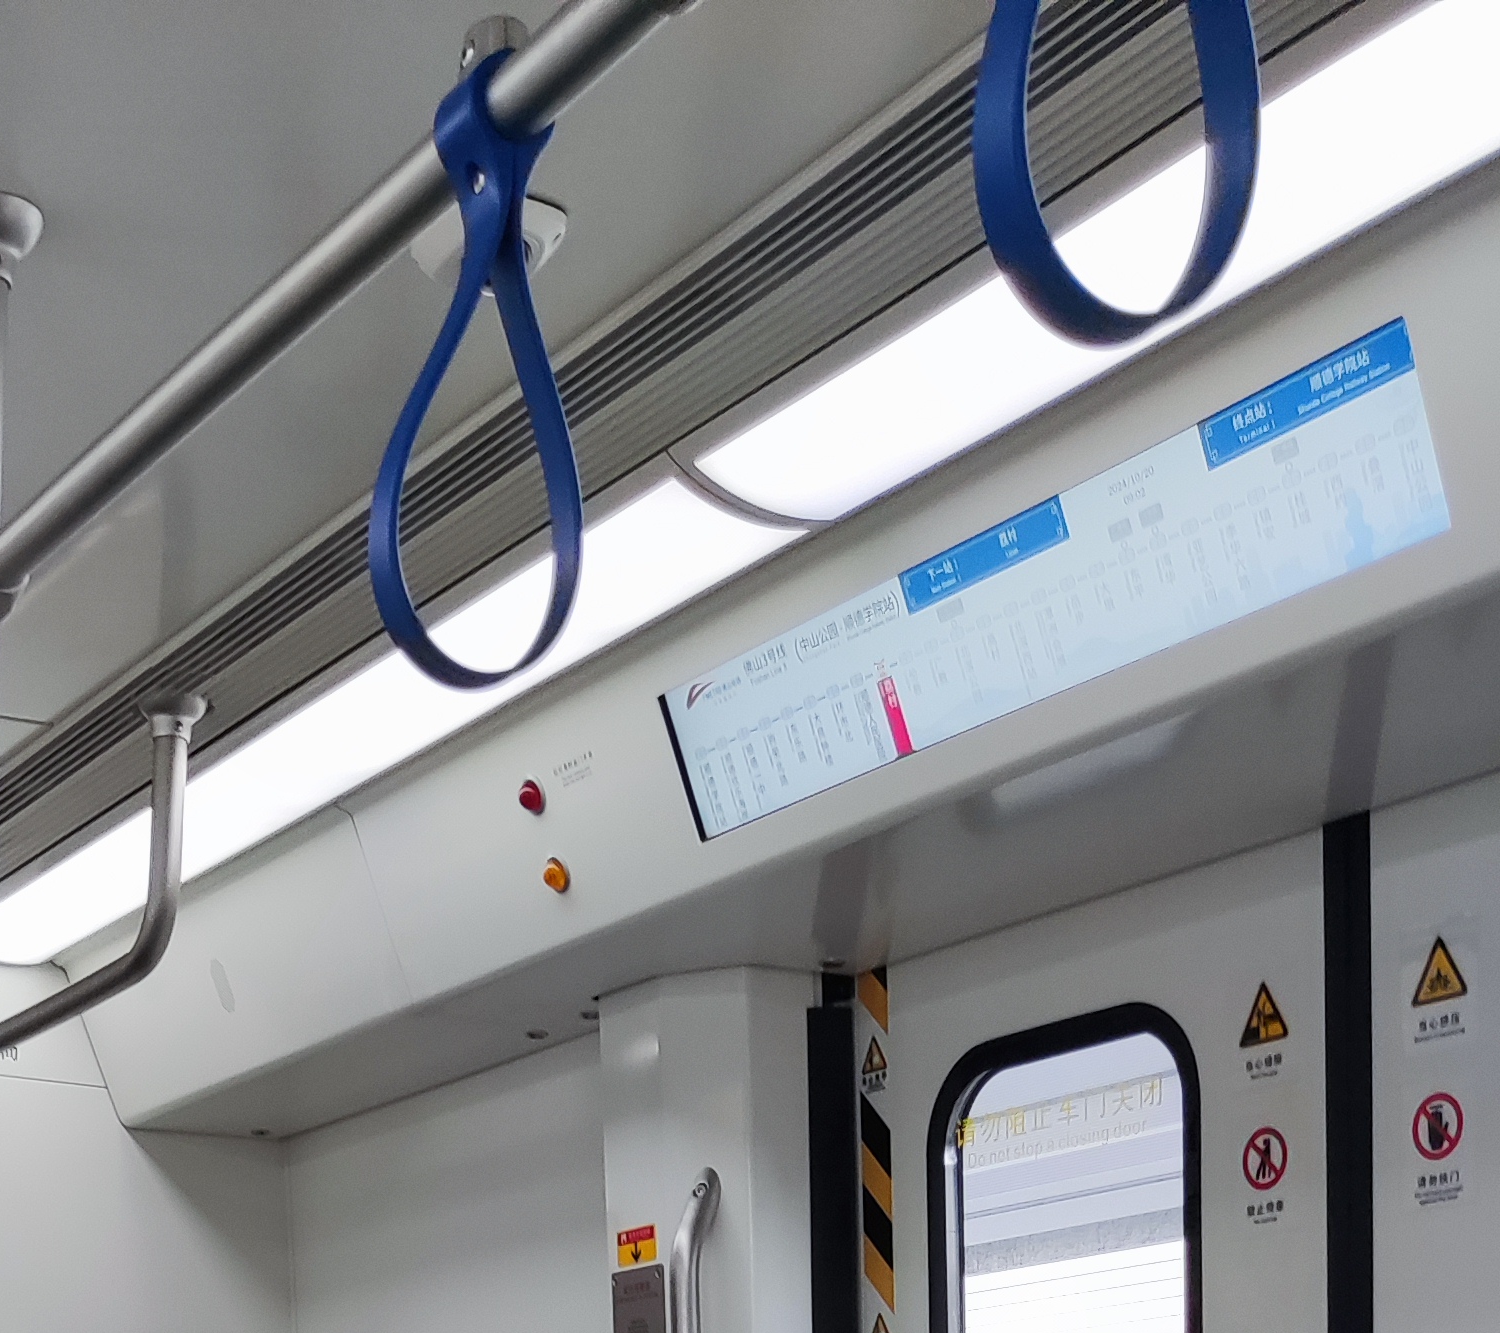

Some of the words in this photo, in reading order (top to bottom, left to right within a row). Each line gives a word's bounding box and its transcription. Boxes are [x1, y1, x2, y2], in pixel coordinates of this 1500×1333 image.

[967, 1152, 986, 1169] Do
[989, 1147, 1011, 1164] not
[1013, 1139, 1043, 1160] stop
[1057, 1127, 1111, 1150] closing
[1113, 1118, 1149, 1138] door
